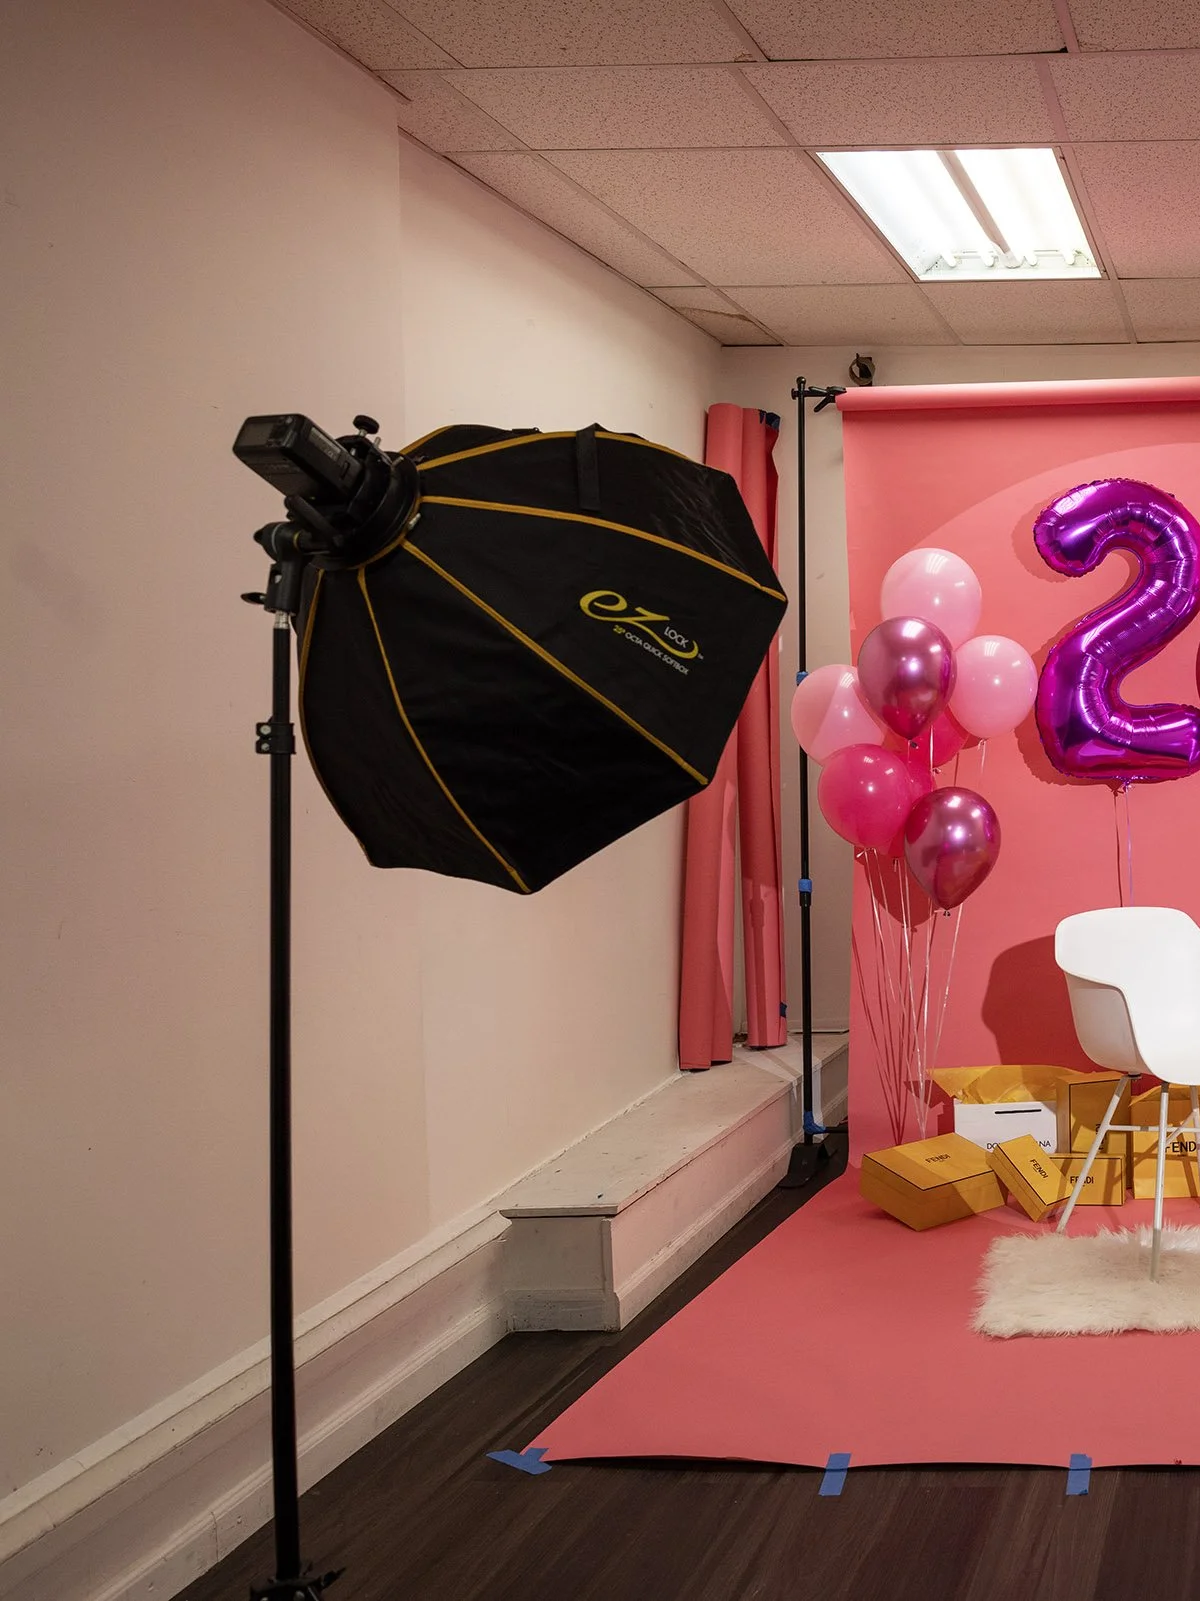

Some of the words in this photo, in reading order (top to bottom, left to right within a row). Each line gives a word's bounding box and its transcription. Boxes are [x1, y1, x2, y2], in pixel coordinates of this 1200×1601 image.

[664, 626, 689, 648] LOCK
[625, 632, 643, 646] OCTA
[643, 642, 663, 658] QUICK
[662, 654, 689, 675] SOFTBOX
[925, 1153, 951, 1163] FENDI
[1029, 1159, 1049, 1179] FENDI
